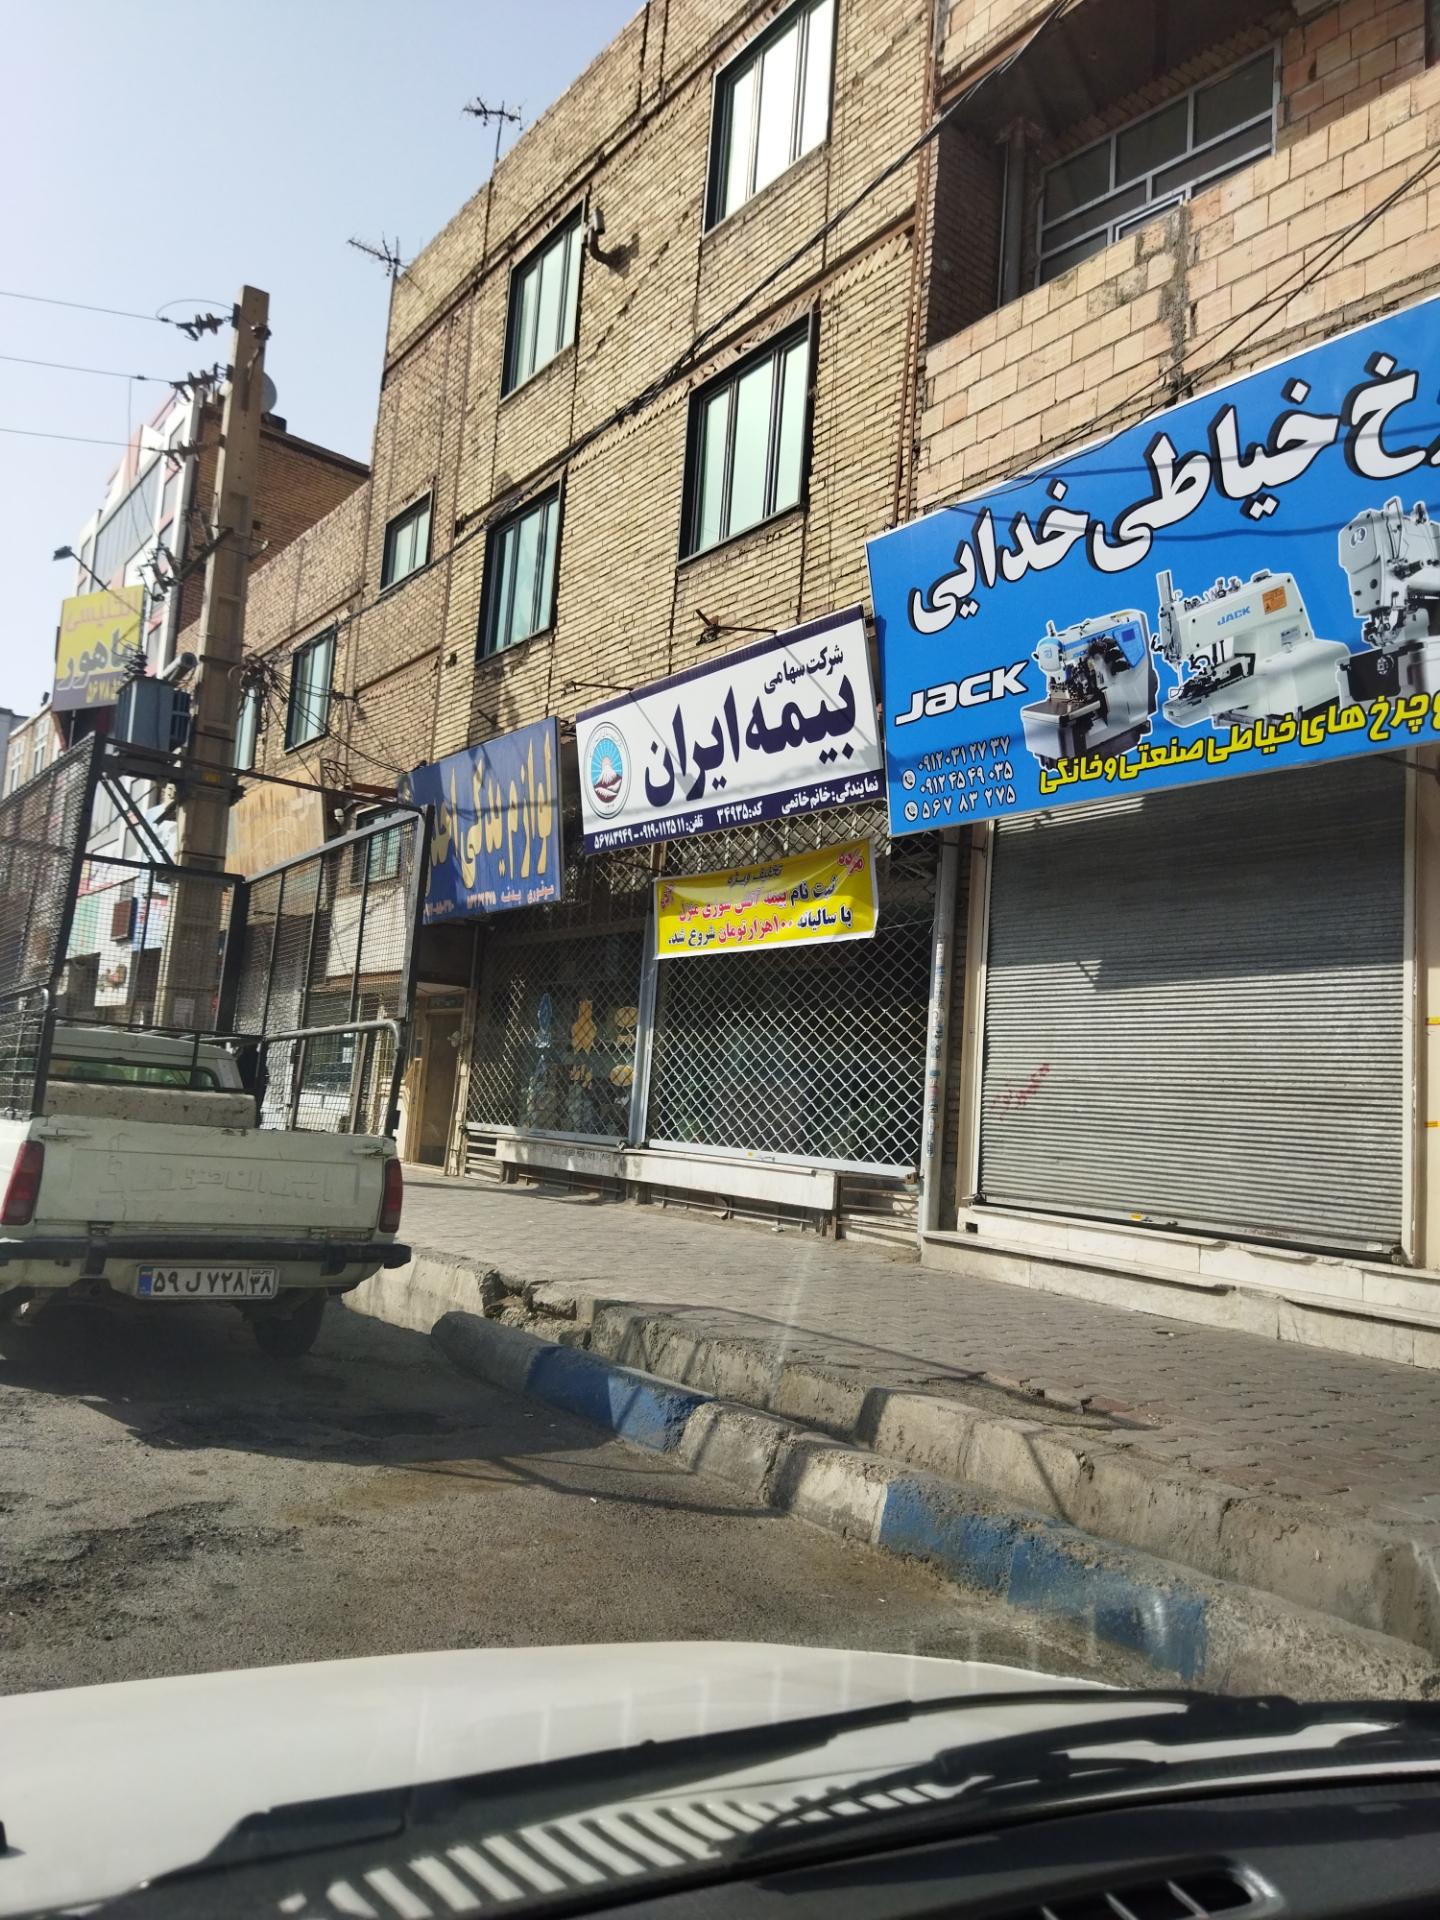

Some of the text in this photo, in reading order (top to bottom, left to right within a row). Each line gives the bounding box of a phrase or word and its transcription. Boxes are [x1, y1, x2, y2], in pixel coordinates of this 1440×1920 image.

[1089, 377, 1341, 574] خیاطی
[910, 477, 1091, 635] خدایی
[1217, 606, 1250, 626] JACK
[763, 644, 844, 695] شرکت سهامی
[644, 674, 856, 807] بیمه ایران
[1206, 711, 1298, 765] خیاطی
[1299, 703, 1367, 746] های
[1368, 692, 1431, 743] چرخ
[1039, 752, 1103, 794] خانگی
[1118, 736, 1205, 781] صنعتی
[461, 758, 506, 890] یدکی
[507, 729, 552, 881] لوازم
[840, 904, 852, 928] با
